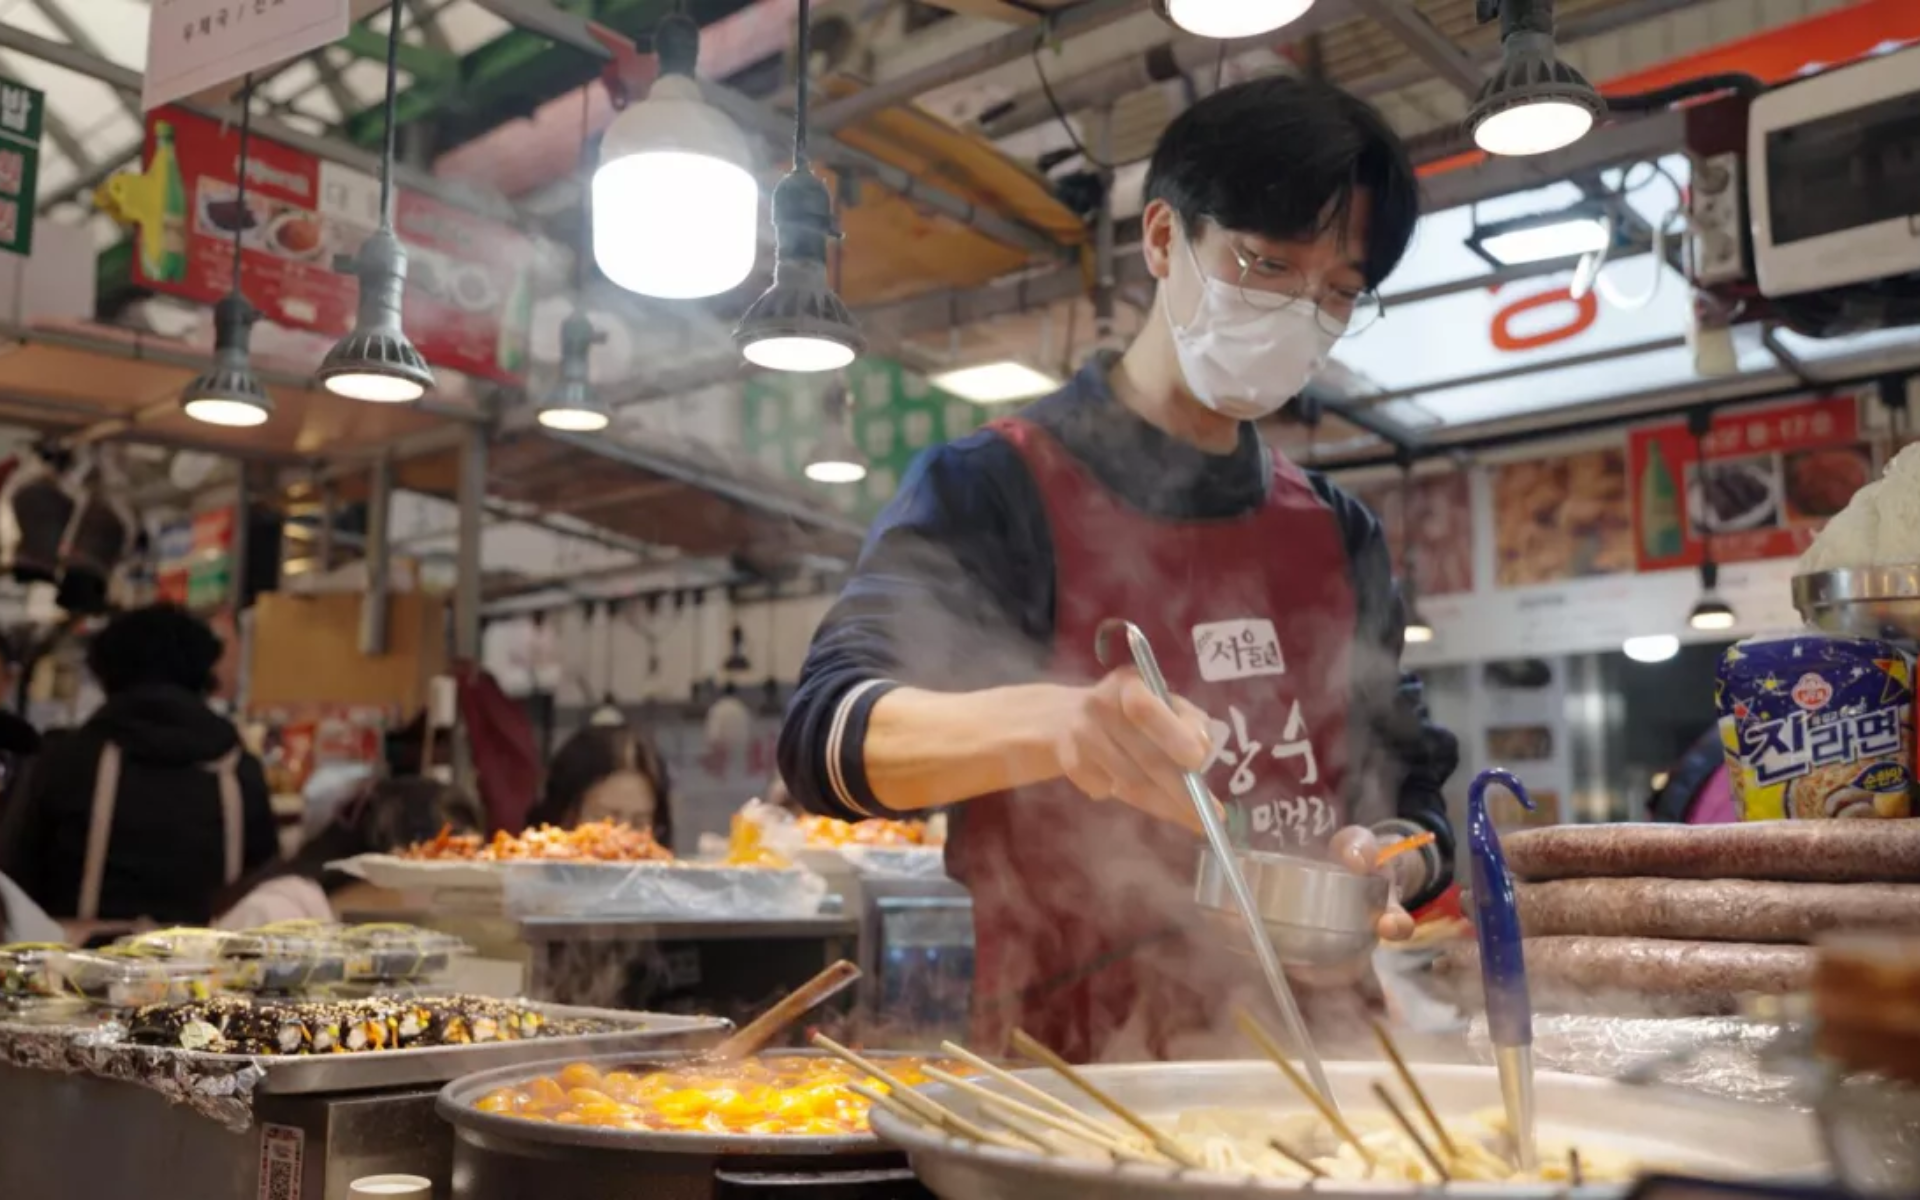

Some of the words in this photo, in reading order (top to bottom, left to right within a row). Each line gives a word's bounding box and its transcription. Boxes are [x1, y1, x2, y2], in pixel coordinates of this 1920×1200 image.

[1200, 699, 1318, 796] 장수
[1745, 708, 1900, 786] 진라면
[1251, 796, 1336, 848] 막걸리
